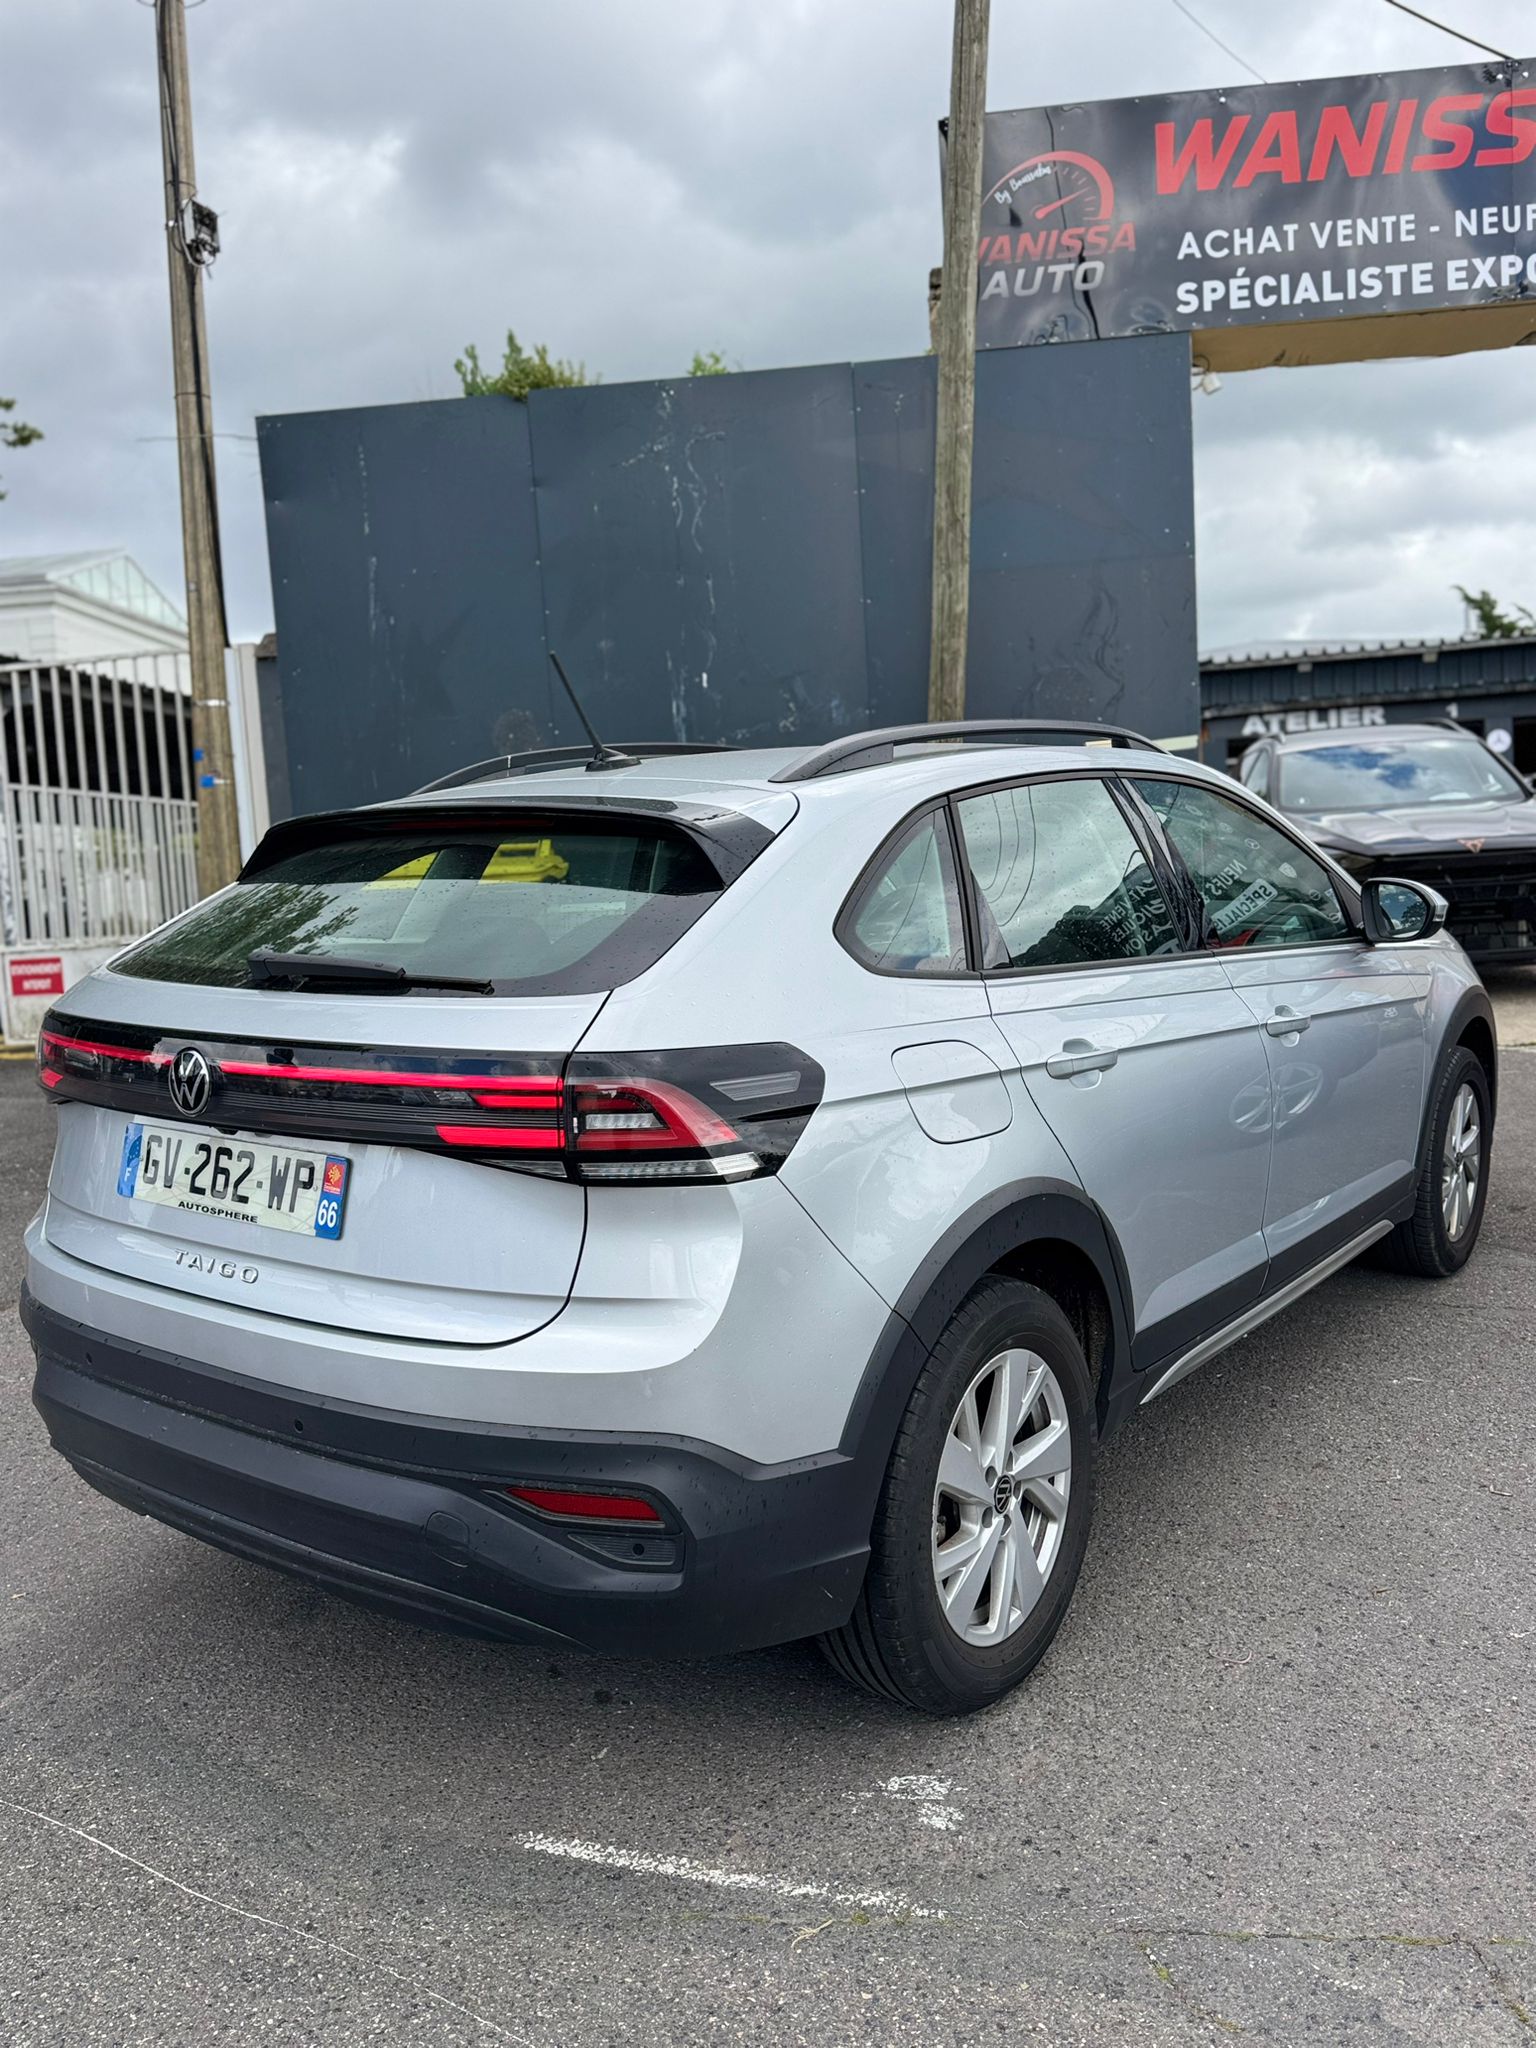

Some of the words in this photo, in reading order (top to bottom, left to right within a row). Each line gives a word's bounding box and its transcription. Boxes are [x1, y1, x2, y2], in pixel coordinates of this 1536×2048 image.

[1177, 224, 1298, 260] ACHAT
[1310, 214, 1416, 249] VENTE
[980, 260, 1105, 300] AUTO
[1176, 262, 1434, 314] SPÉCIALISTE
[1241, 705, 1386, 736] ATELIER
[123, 1167, 132, 1182] F
[178, 1200, 259, 1224] AUTOSPHERE
[317, 1199, 339, 1229] 66
[174, 1249, 260, 1284] TAIGO
